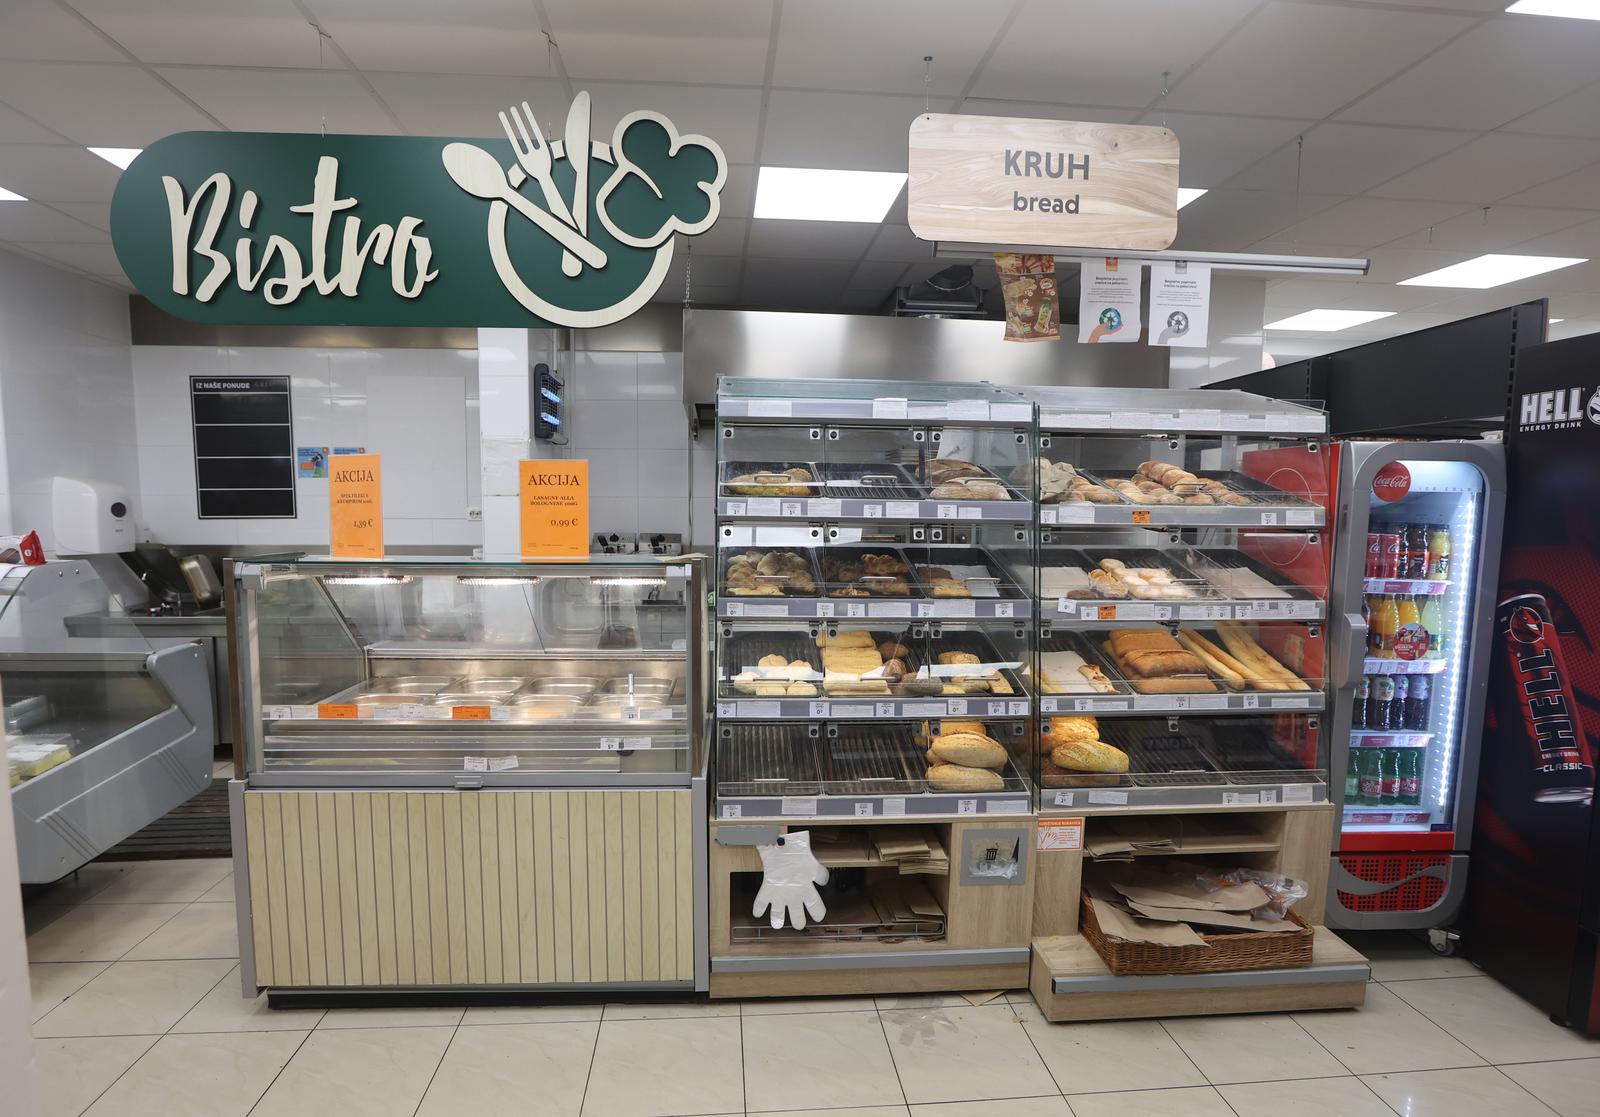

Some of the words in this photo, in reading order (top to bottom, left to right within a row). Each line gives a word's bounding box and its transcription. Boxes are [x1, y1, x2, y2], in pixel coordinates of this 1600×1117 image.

[1004, 149, 1090, 180] KRUH
[1013, 191, 1080, 214] bread
[161, 155, 439, 305] Bistro
[203, 381, 221, 389] NAŠE
[1520, 387, 1583, 425] HELL
[1520, 424, 1552, 432] ENERGY
[1554, 421, 1582, 429] DRINK
[335, 470, 374, 482] AKCIJA
[528, 474, 580, 486] AKCIJA
[353, 520, 367, 529] 1,39
[368, 518, 374, 527] €
[550, 519, 570, 528] 0,99
[571, 518, 578, 526] €
[1518, 649, 1578, 752] HELL
[1543, 763, 1583, 772] CLASSIC
